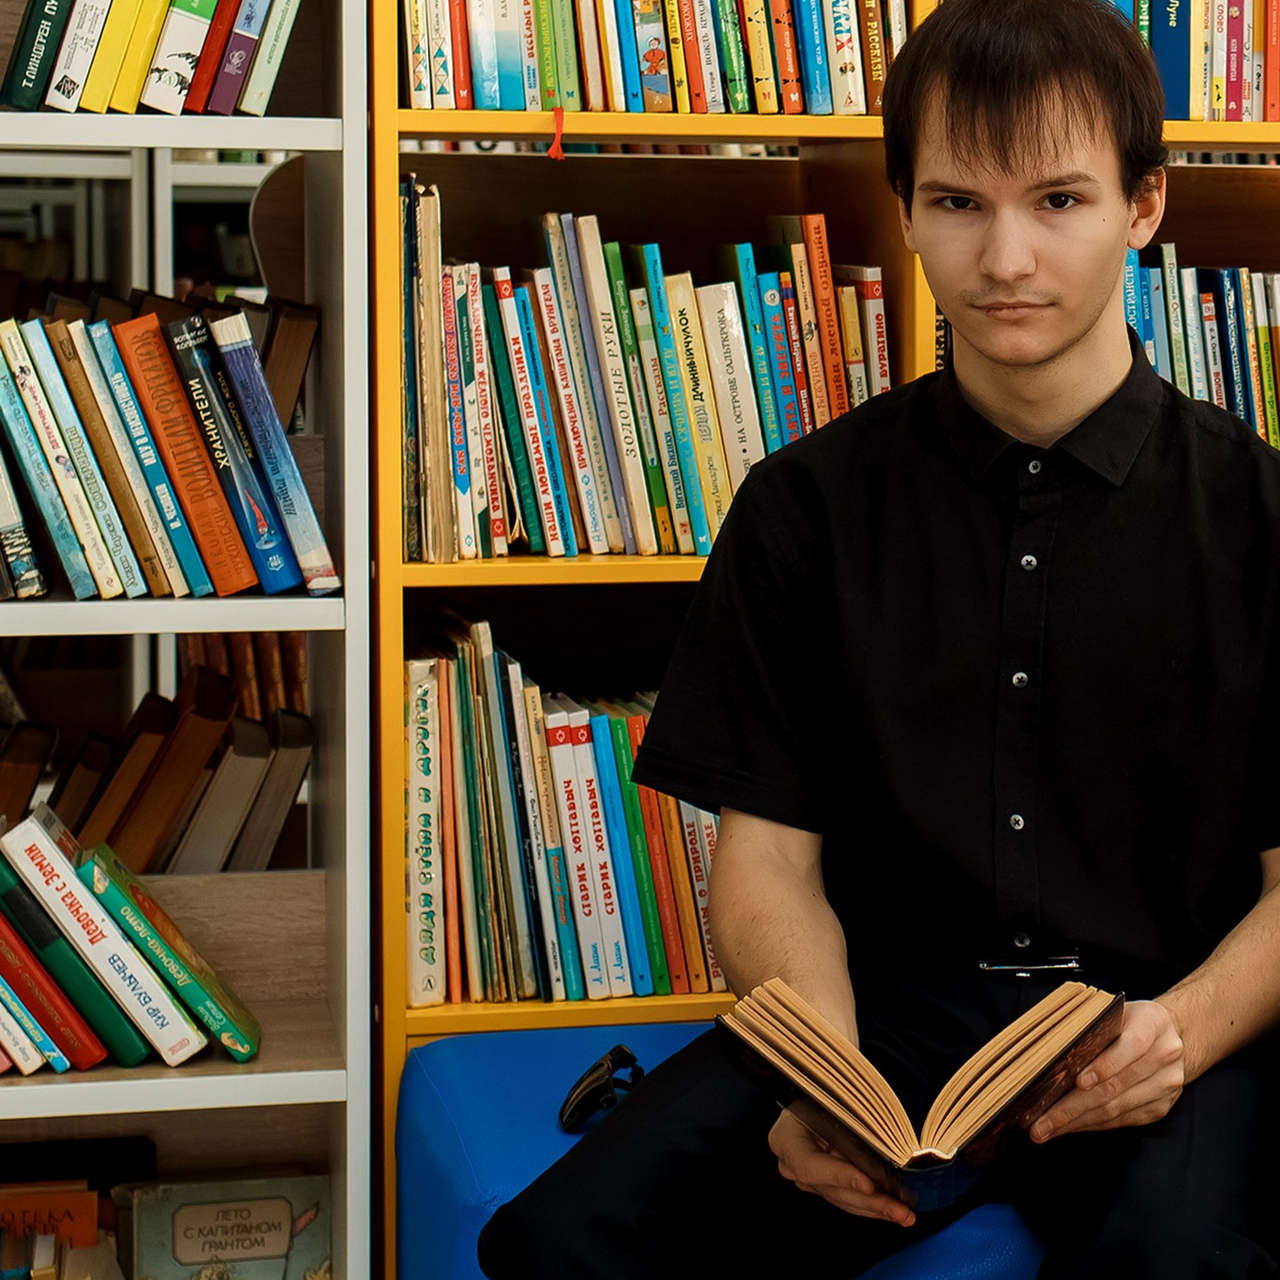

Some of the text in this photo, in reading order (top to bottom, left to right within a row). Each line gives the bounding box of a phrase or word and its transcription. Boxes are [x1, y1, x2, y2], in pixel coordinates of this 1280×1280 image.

[728, 378, 743, 424] ОСТРОВЕ
[188, 377, 230, 469] ХРАНИТЕЛИ
[735, 427, 747, 444] НА
[107, 953, 170, 1030] КИР БУЛЫЧЕВ
[216, 1208, 251, 1222] ЛЕТО
[197, 1221, 283, 1238] КАПИТАНОМ
[202, 1237, 265, 1252] ГРАНТОМ
